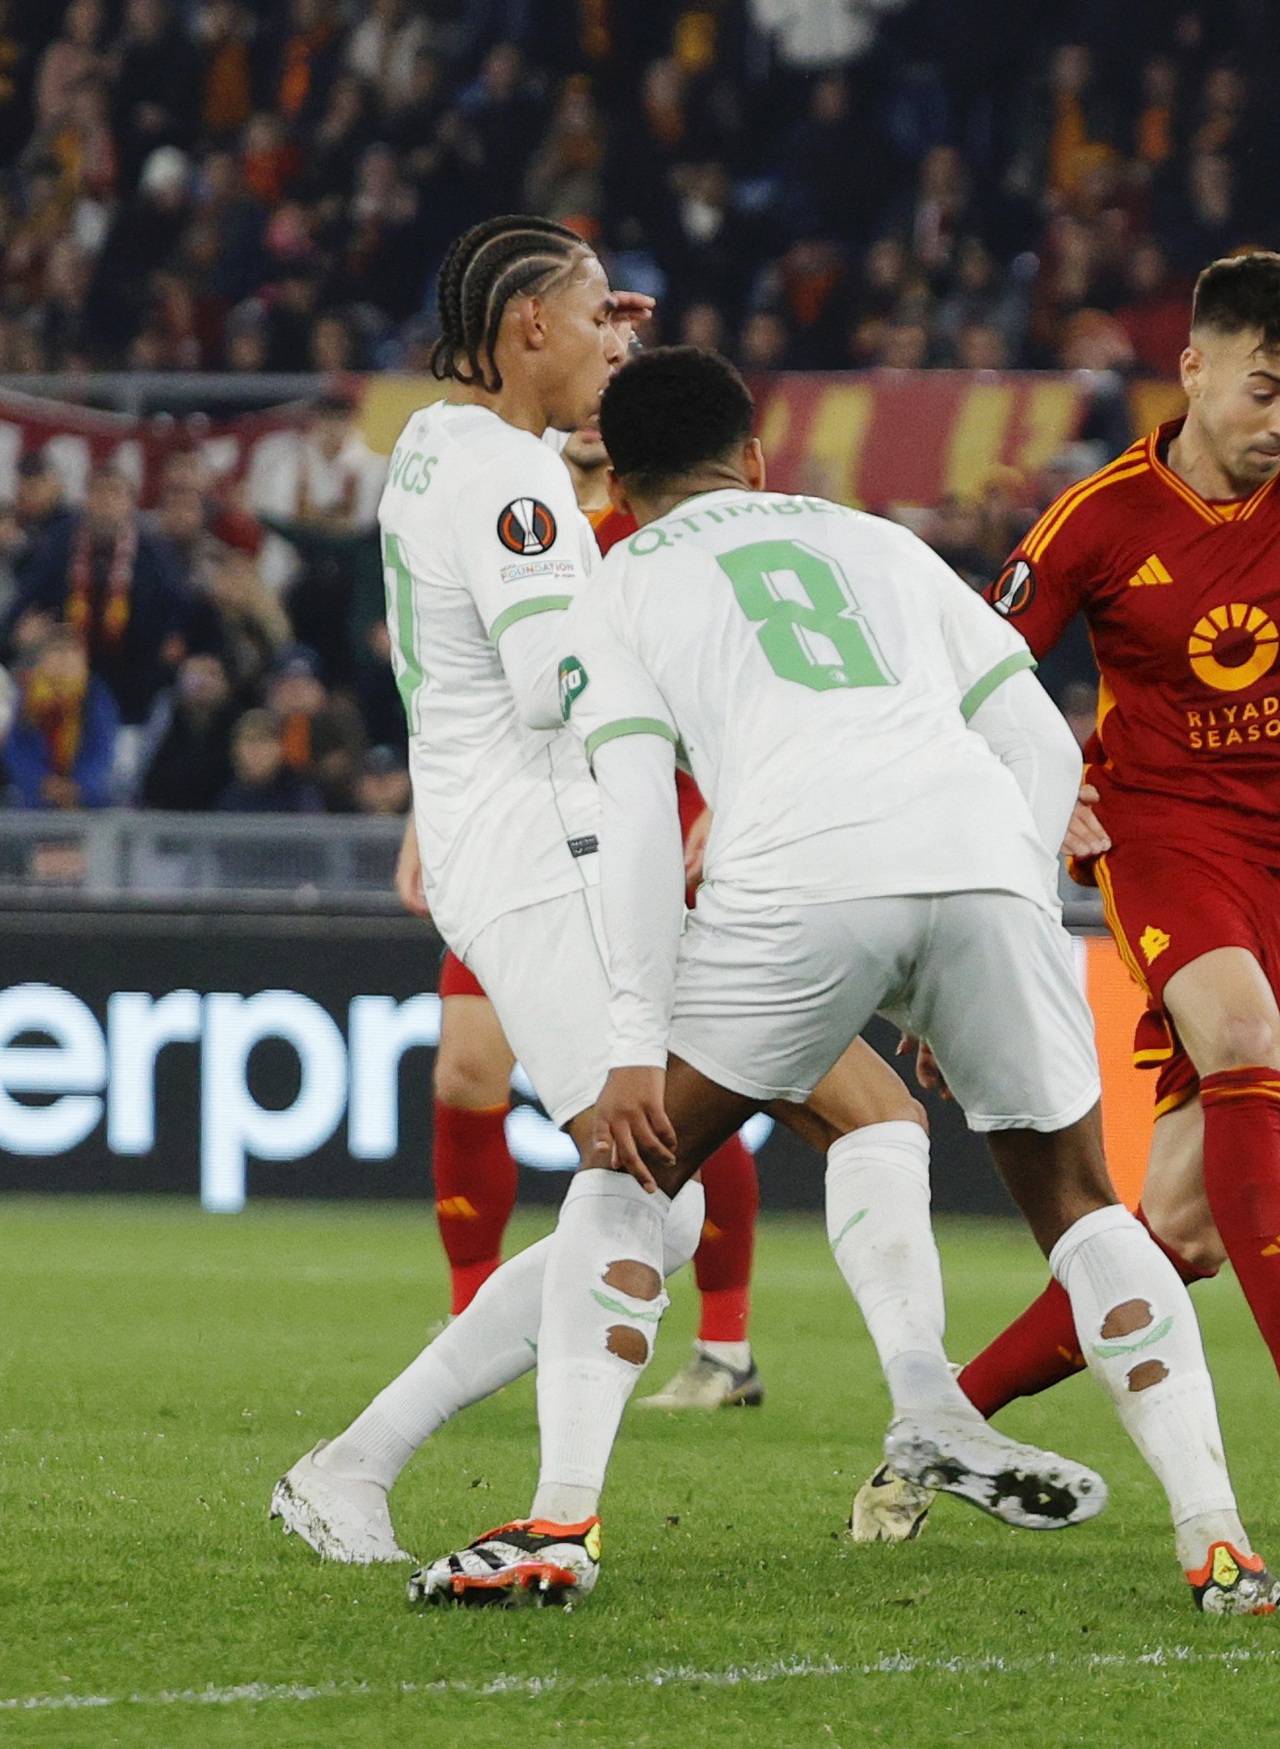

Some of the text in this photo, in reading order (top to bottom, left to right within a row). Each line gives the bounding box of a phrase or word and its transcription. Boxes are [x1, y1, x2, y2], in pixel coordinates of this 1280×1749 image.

[391, 446, 439, 495] NGS
[628, 498, 848, 556] Q.TIMBE
[715, 538, 901, 692] 8
[0, 981, 774, 1213] erpr
